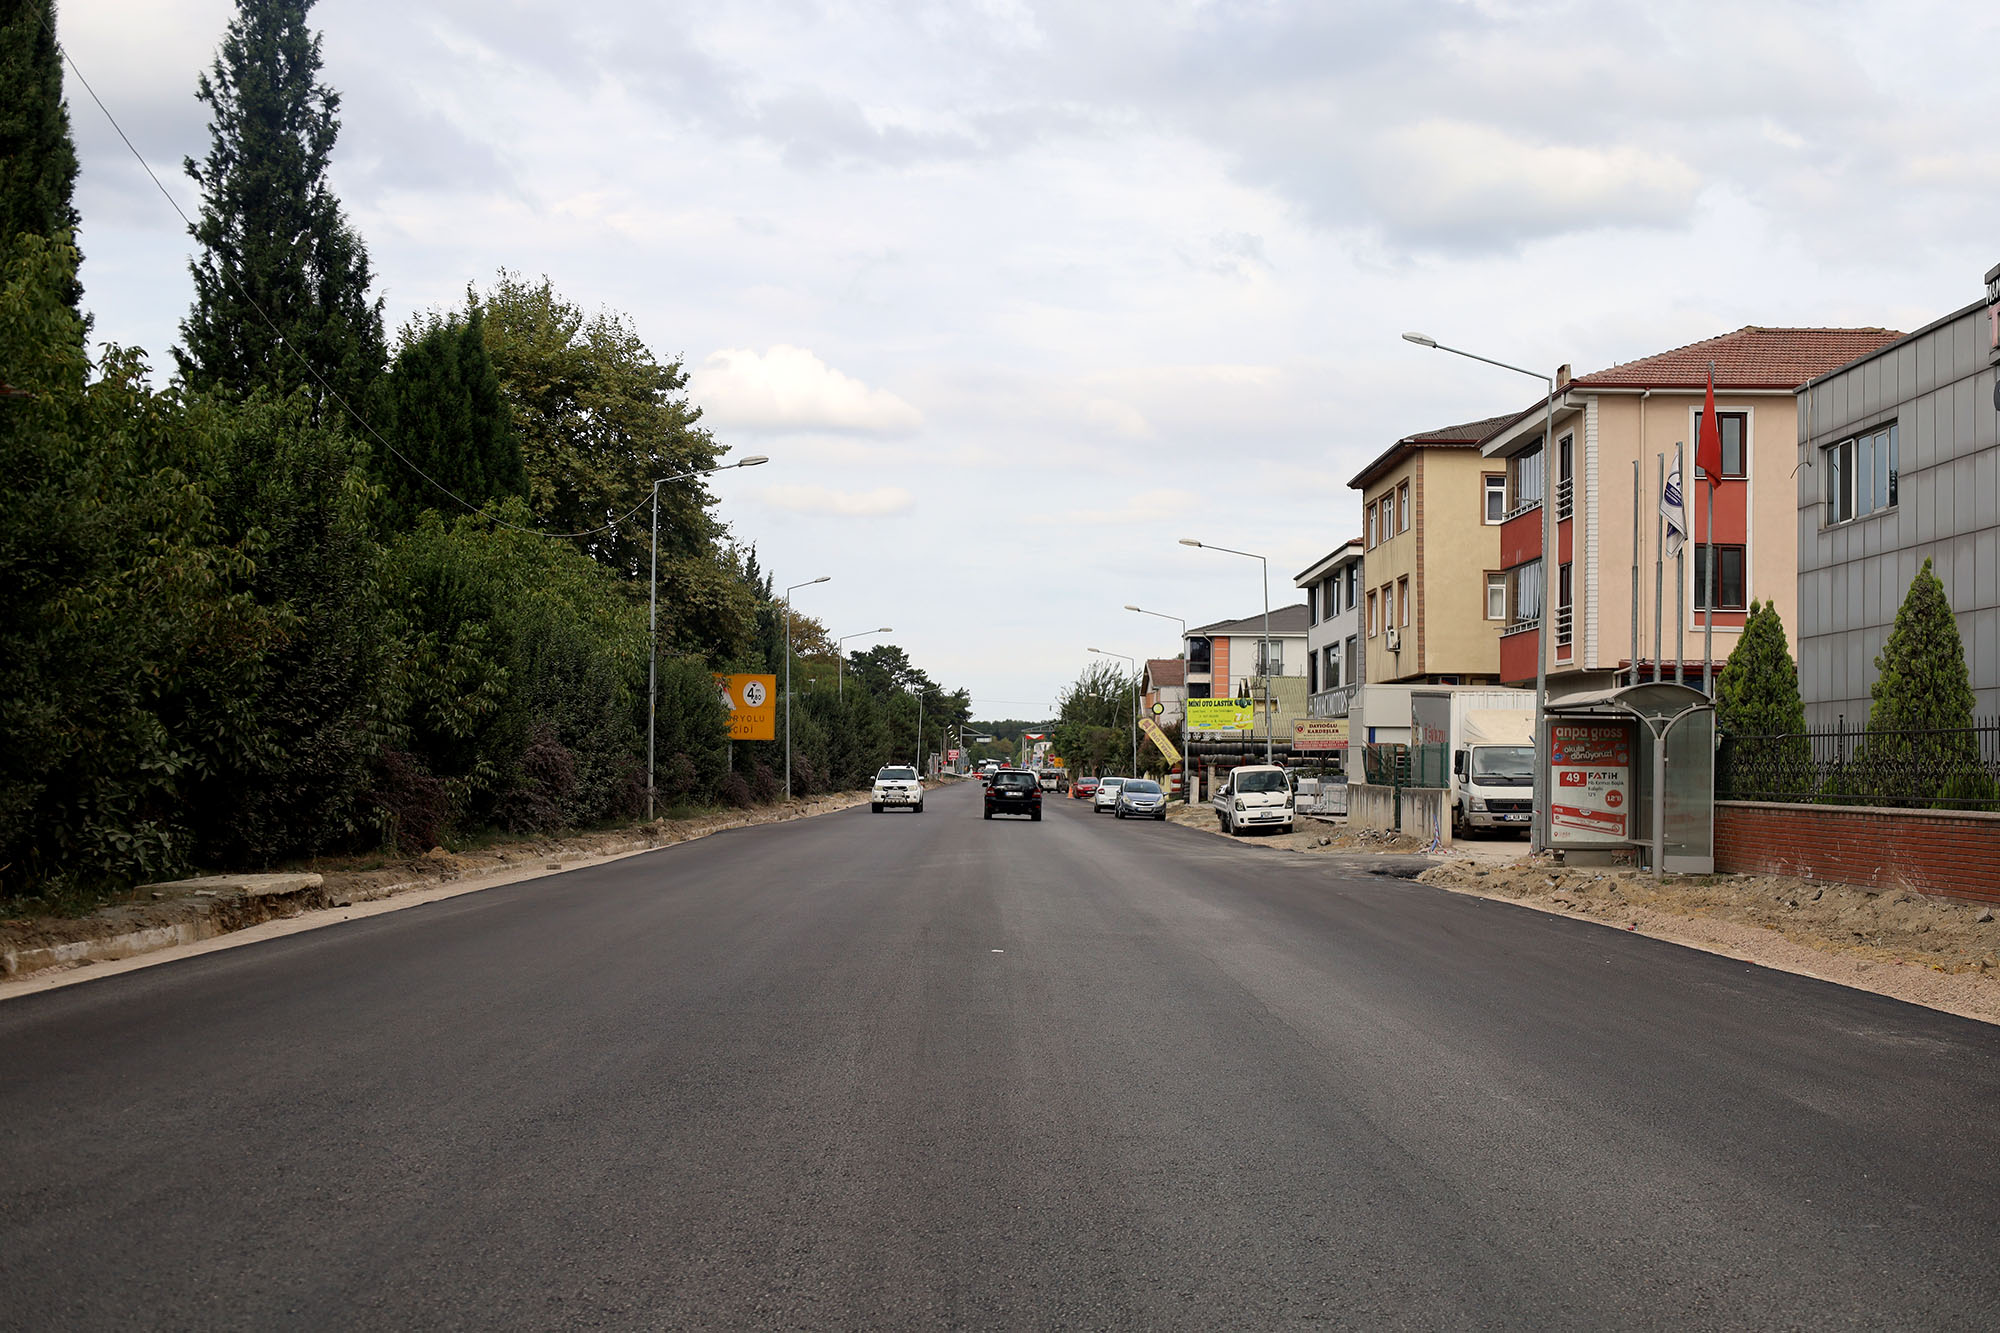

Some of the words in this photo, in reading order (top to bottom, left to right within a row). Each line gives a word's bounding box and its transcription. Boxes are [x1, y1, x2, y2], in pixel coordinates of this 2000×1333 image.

[747, 687, 754, 700] 4
[1556, 728, 1588, 740] anpa
[1591, 728, 1623, 741] gross
[1563, 744, 1585, 753] okula
[1566, 772, 1580, 783] 49
